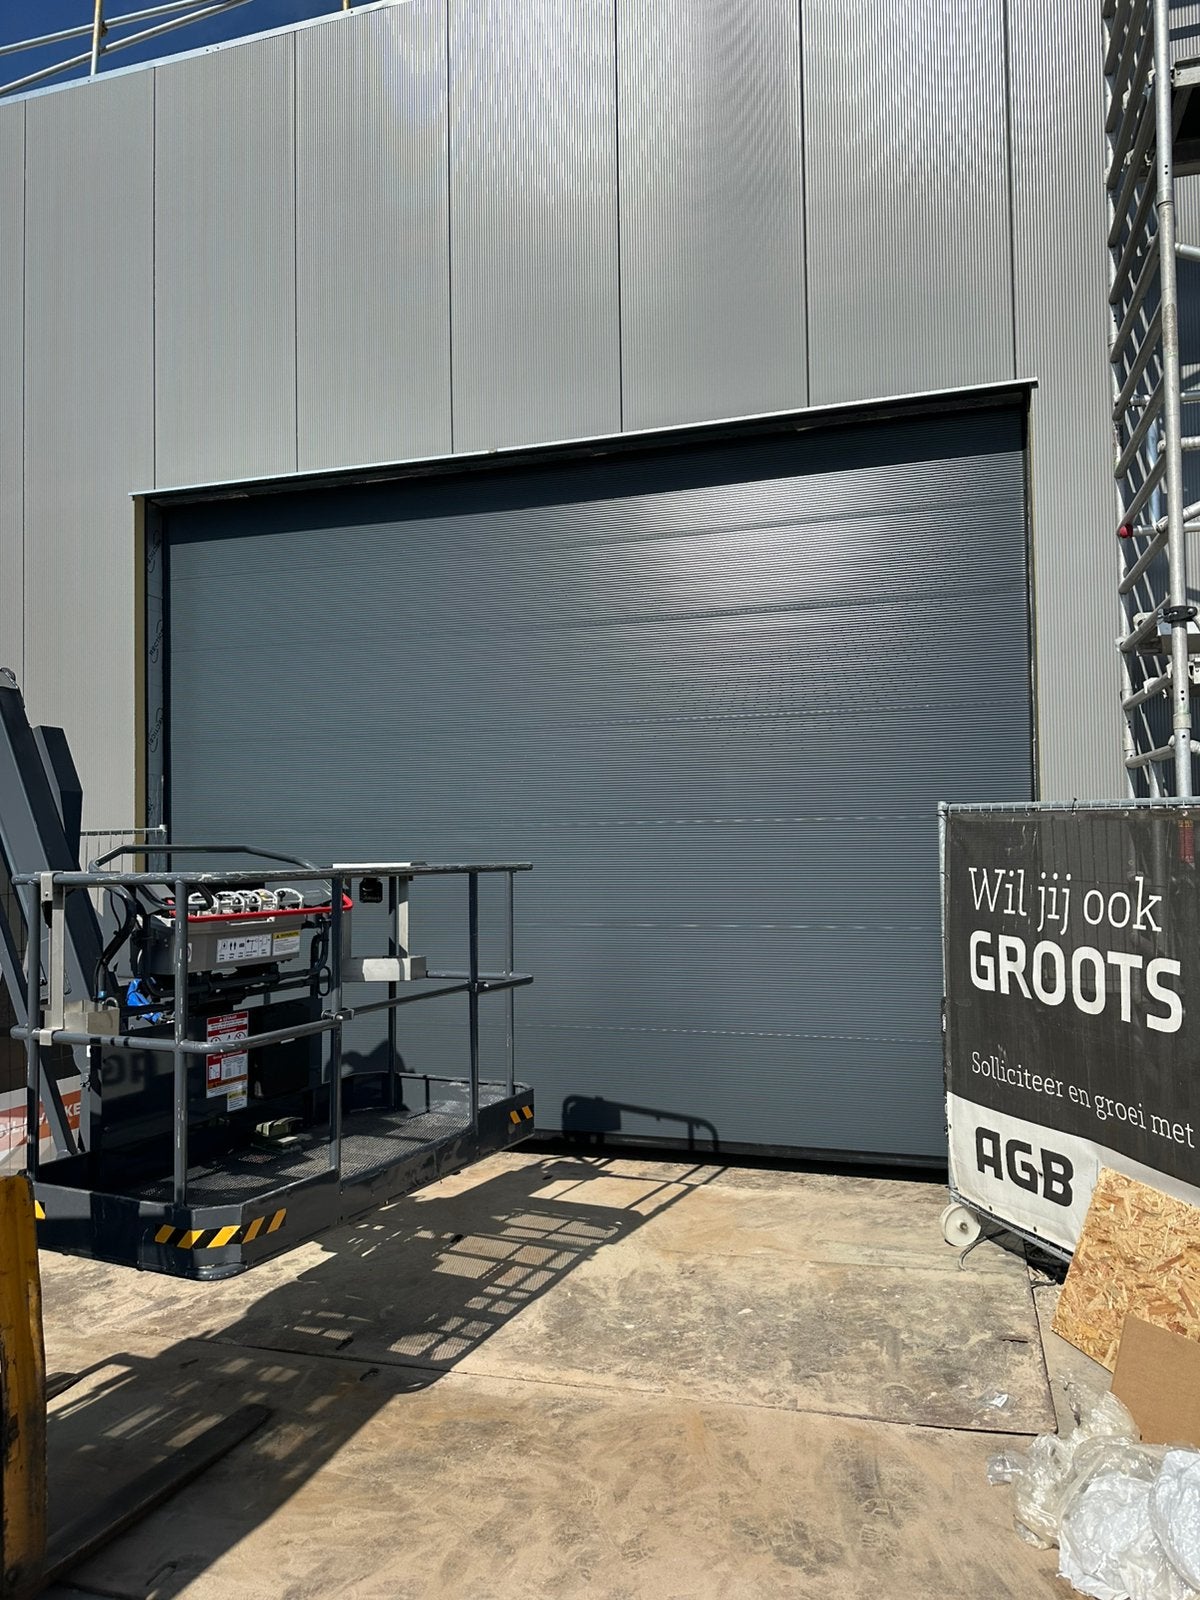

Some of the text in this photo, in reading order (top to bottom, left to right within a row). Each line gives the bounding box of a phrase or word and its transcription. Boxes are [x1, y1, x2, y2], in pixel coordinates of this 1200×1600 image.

[968, 867, 1162, 935] Wil jij ook
[970, 930, 1183, 1033] GROOTS
[971, 1051, 1195, 1148] Solliciteer en groei met
[975, 1126, 1074, 1207] AGB
